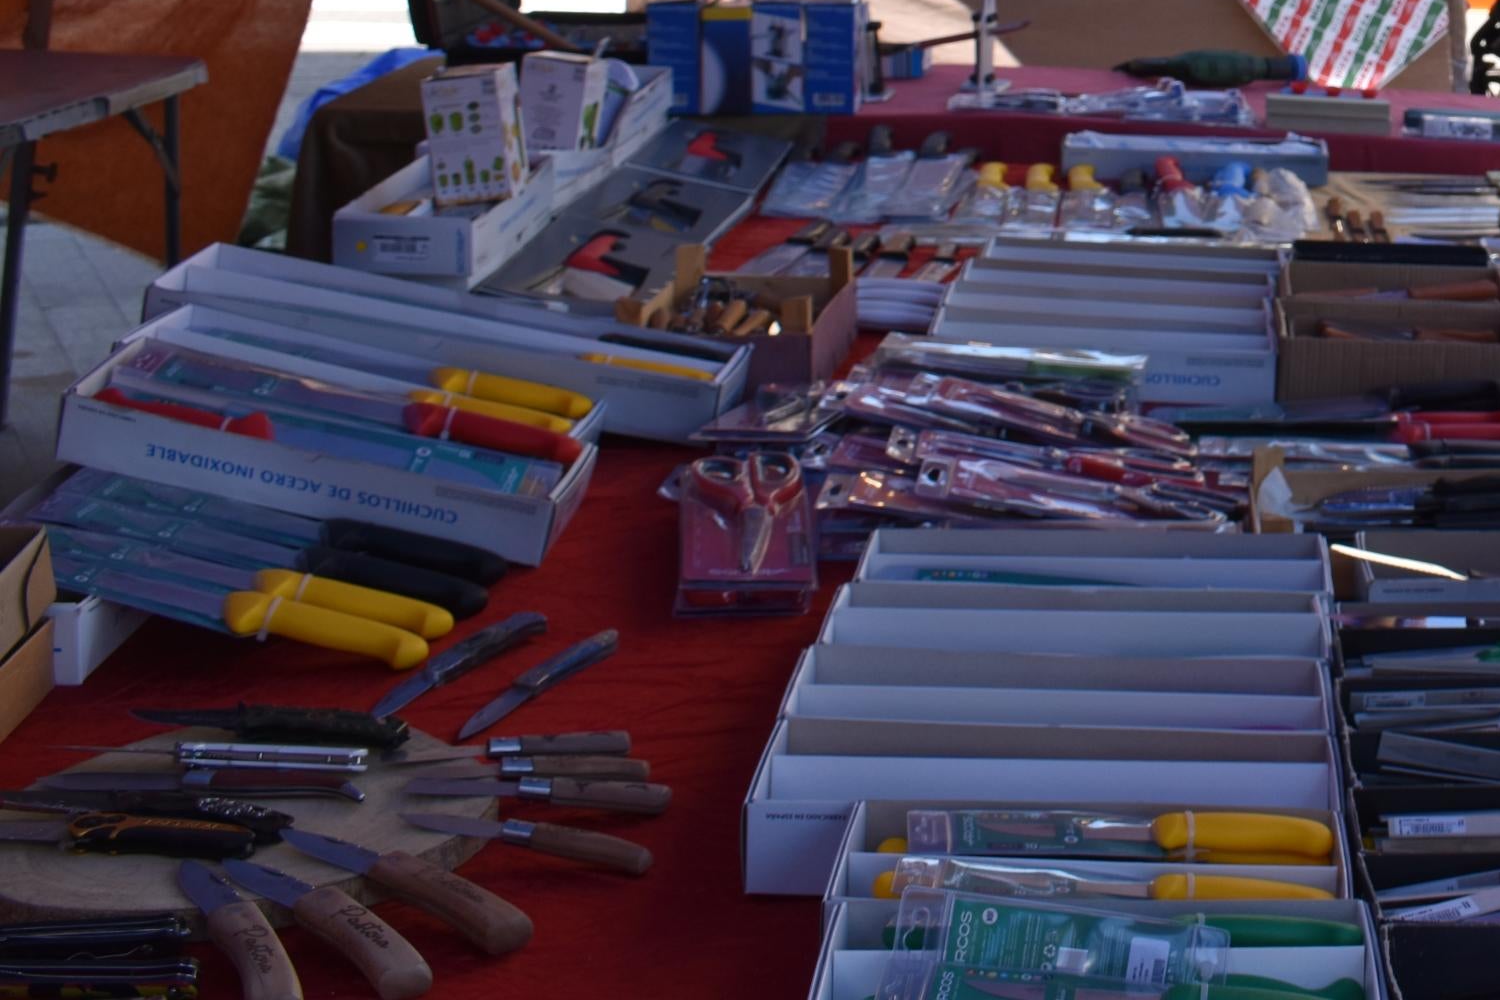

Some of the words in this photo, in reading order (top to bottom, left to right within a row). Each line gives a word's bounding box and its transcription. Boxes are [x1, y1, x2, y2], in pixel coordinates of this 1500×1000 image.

[145, 443, 253, 479] INOXIDABLE
[260, 470, 322, 494] ACERO
[327, 486, 351, 501] DE
[358, 491, 458, 524] CUCHILLOS
[954, 911, 973, 963] RCOS
